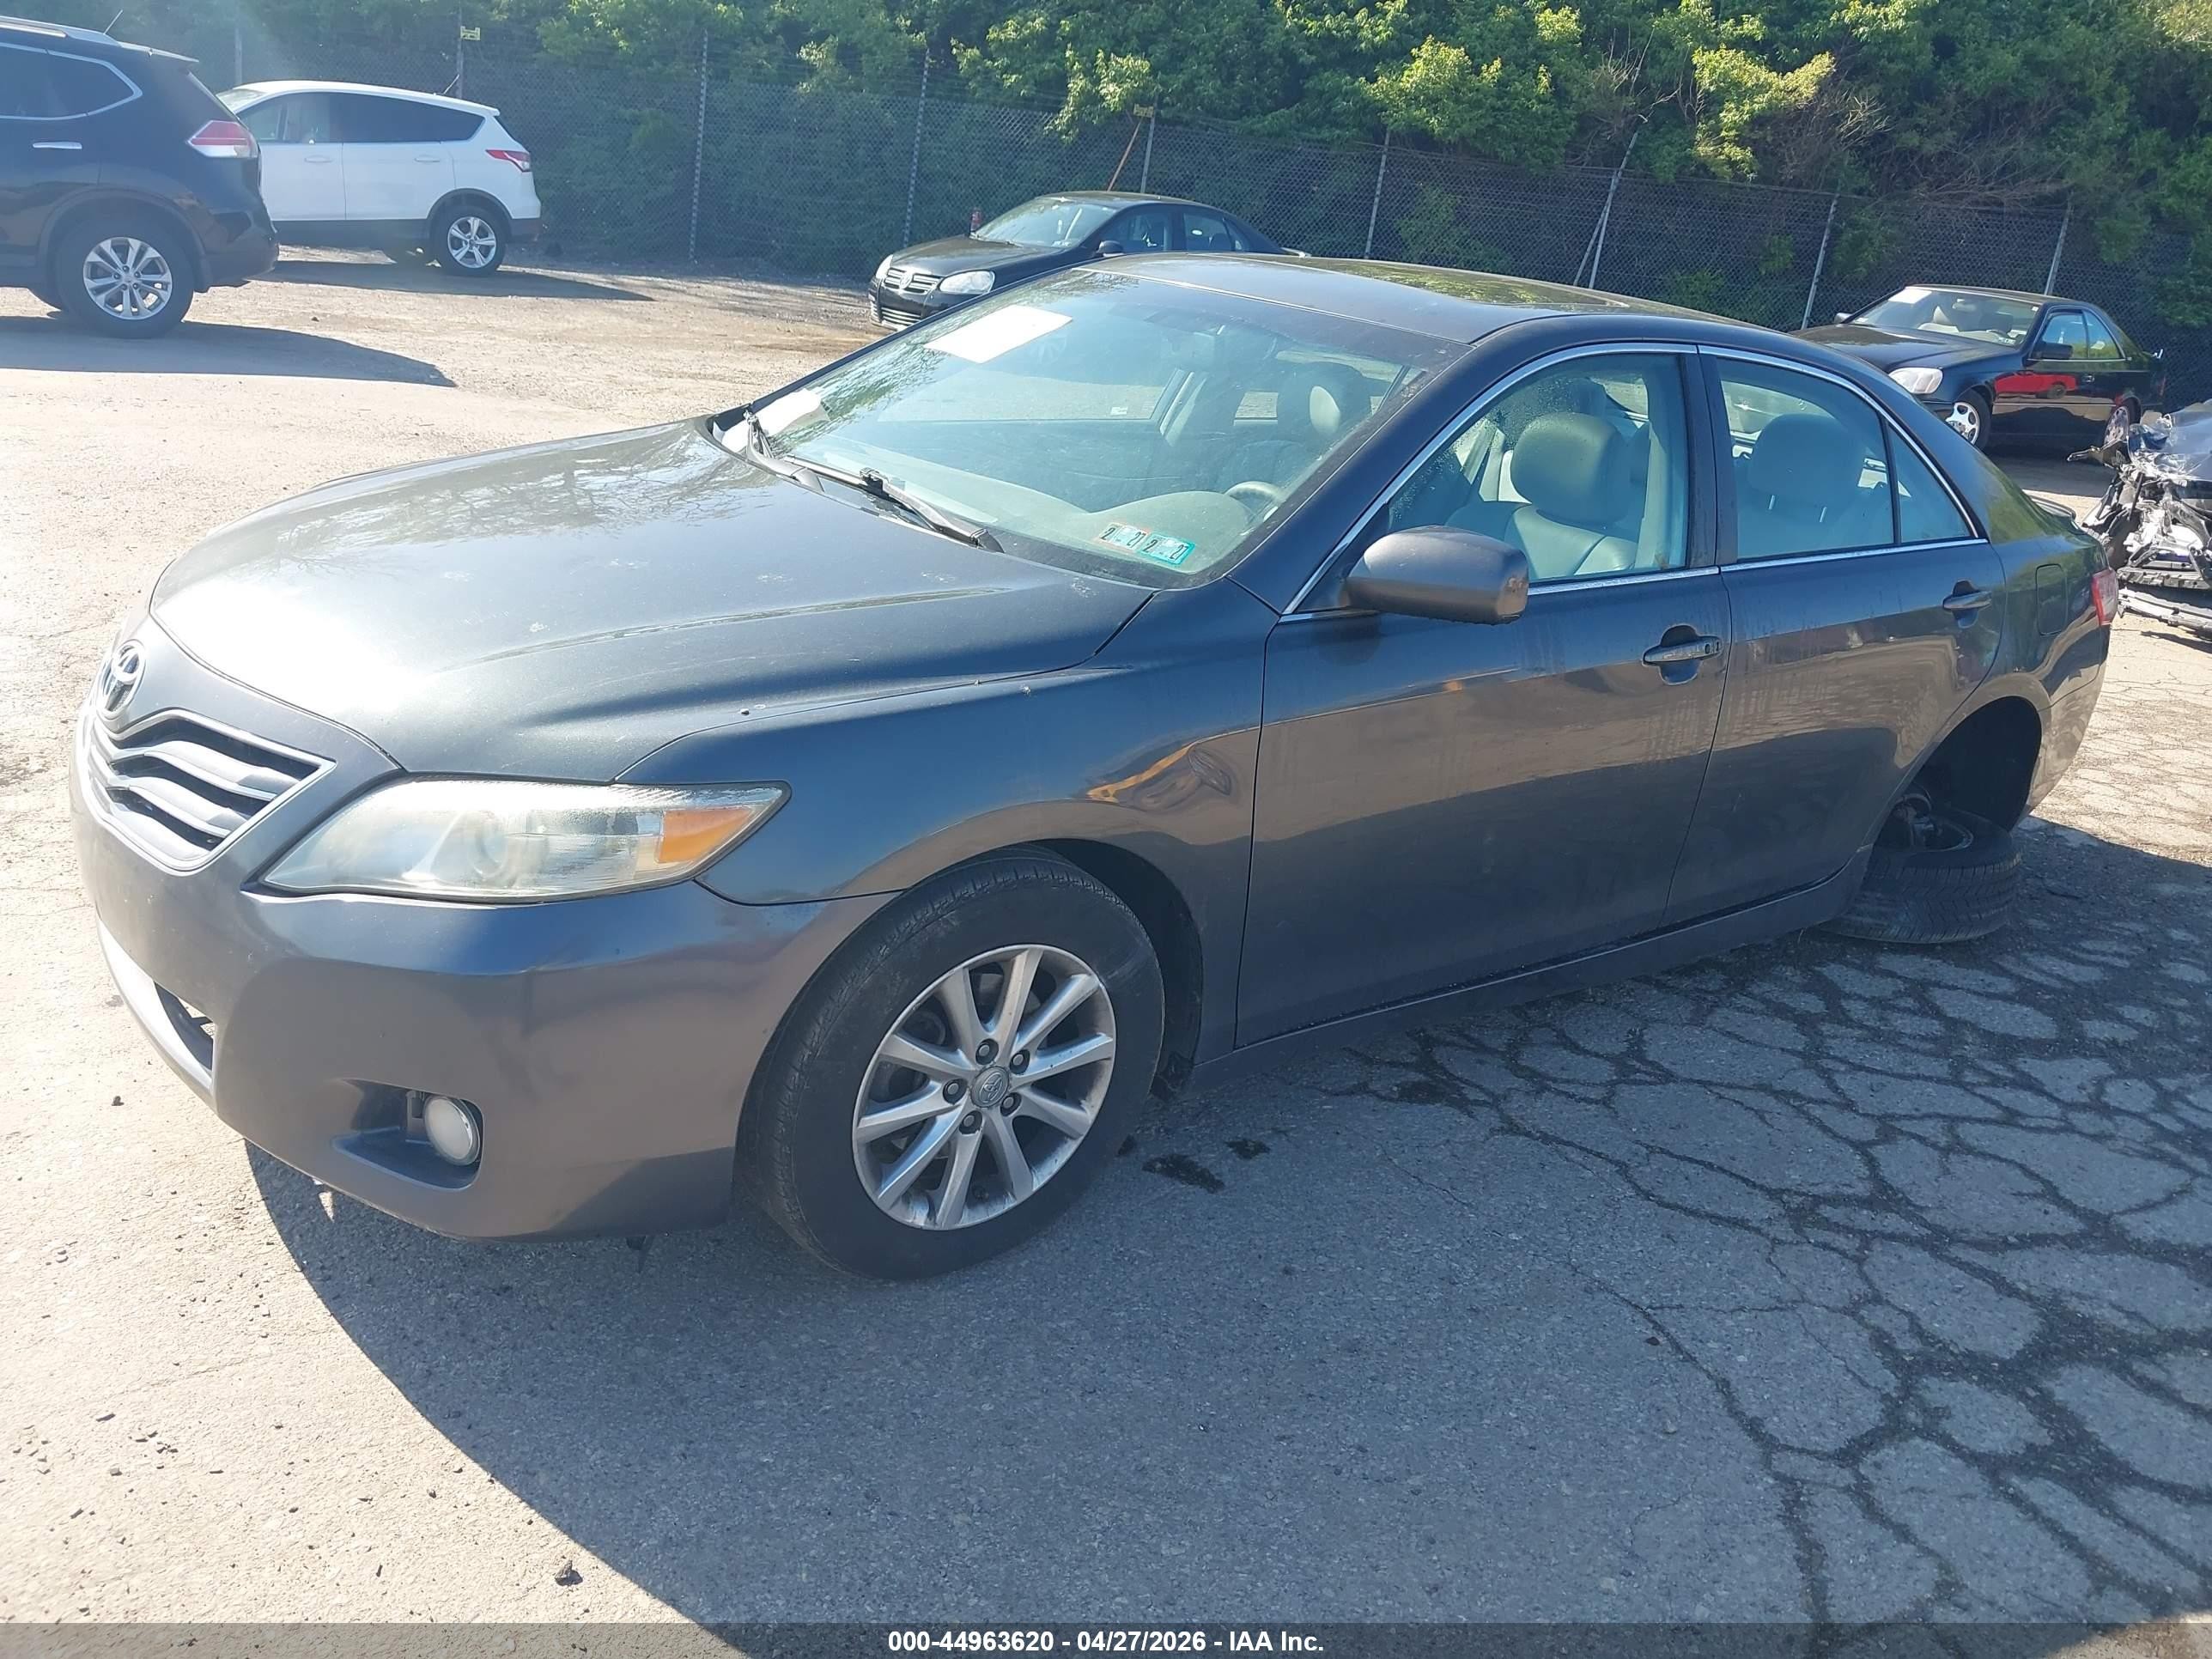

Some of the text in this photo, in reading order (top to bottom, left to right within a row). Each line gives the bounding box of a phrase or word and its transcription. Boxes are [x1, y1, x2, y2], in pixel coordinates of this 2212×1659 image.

[1101, 527, 1147, 549] 2 27
[1142, 539, 1189, 562] 2 27
